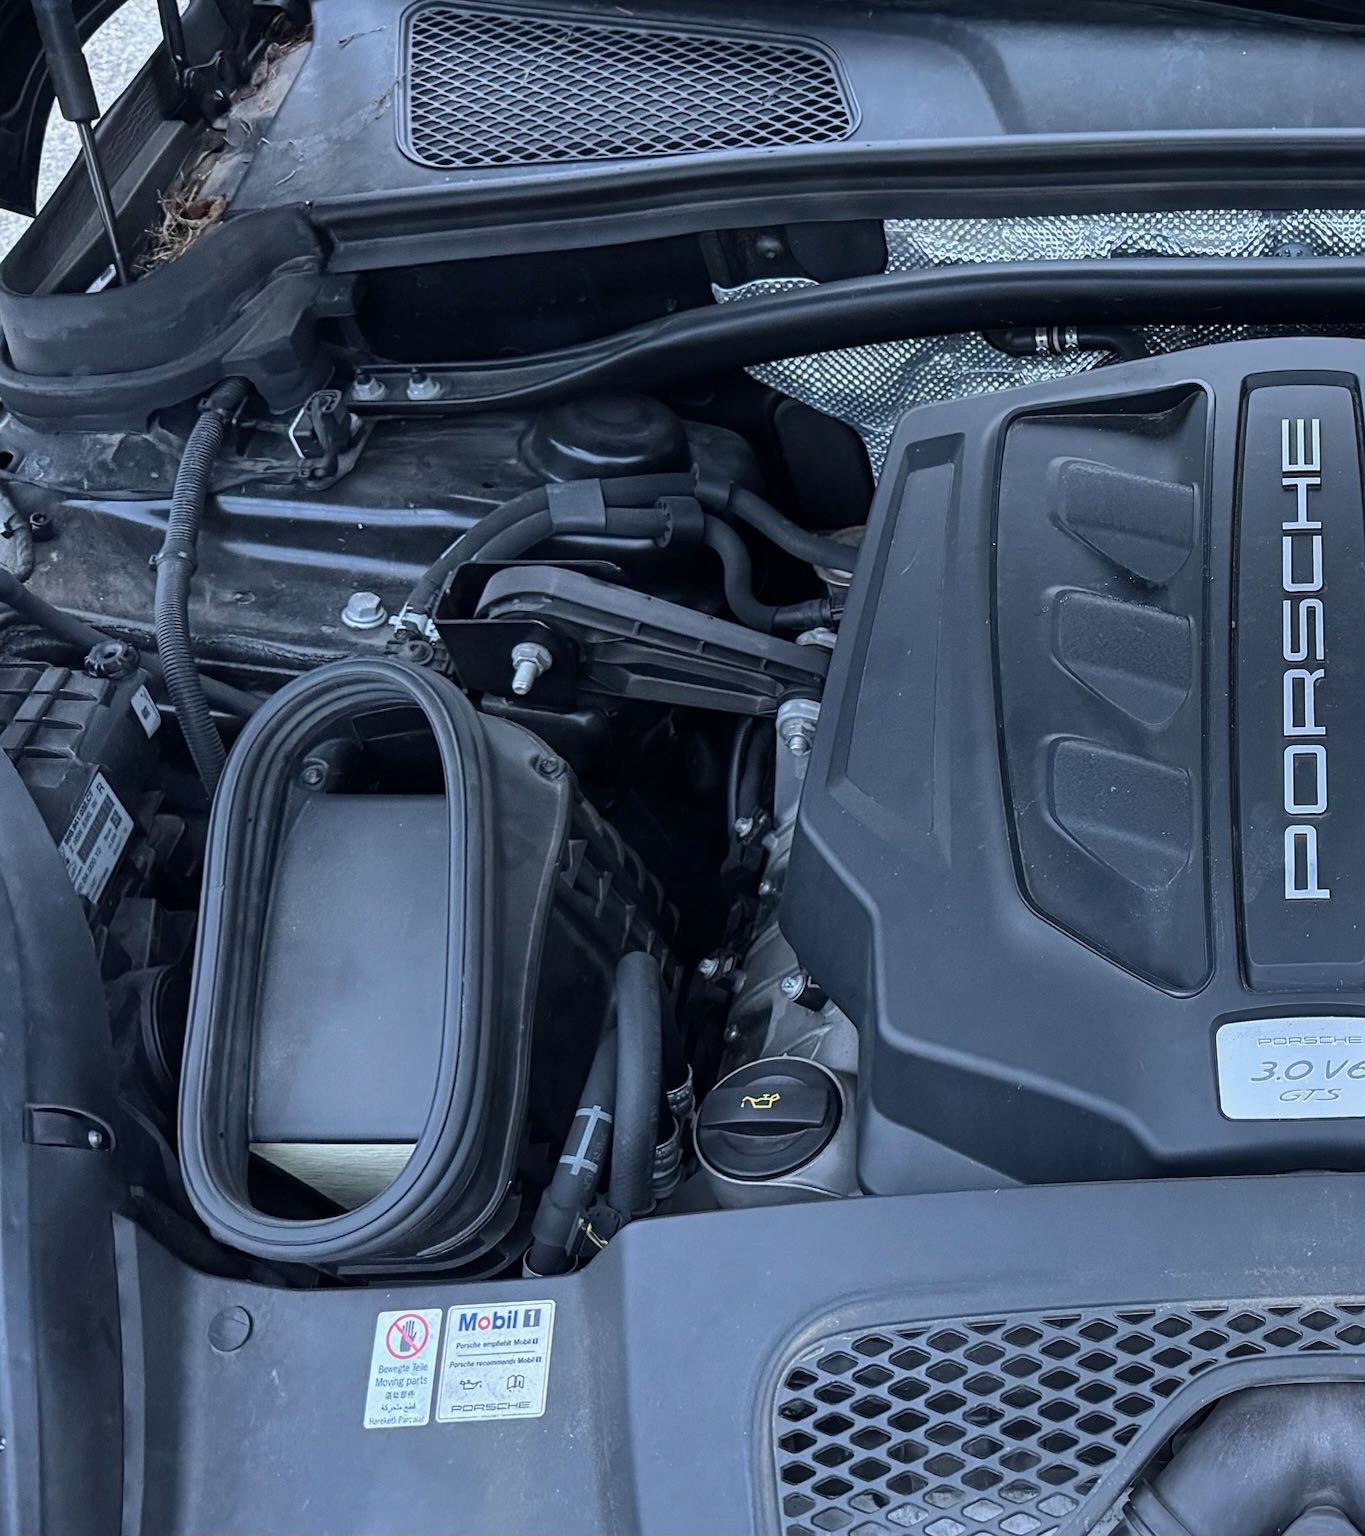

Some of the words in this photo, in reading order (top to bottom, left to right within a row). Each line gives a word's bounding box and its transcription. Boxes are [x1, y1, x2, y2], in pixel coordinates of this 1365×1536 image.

[1282, 418, 1330, 900] PORSCHE
[96, 780, 104, 795] R
[1258, 1036, 1363, 1046] PORSCHE
[1251, 1060, 1313, 1082] 3.0
[1279, 1088, 1342, 1102] GTS
[458, 1310, 519, 1332] Mobil
[455, 1342, 481, 1350] Porsche
[513, 1338, 531, 1346] Mobil
[378, 1364, 410, 1374] Bewegte
[412, 1363, 429, 1372] Teile
[449, 1361, 475, 1369] Porsche
[476, 1358, 516, 1367] recommends
[375, 1377, 404, 1388] Moving
[406, 1376, 429, 1387] parts
[451, 1401, 532, 1413] PORSCHE
